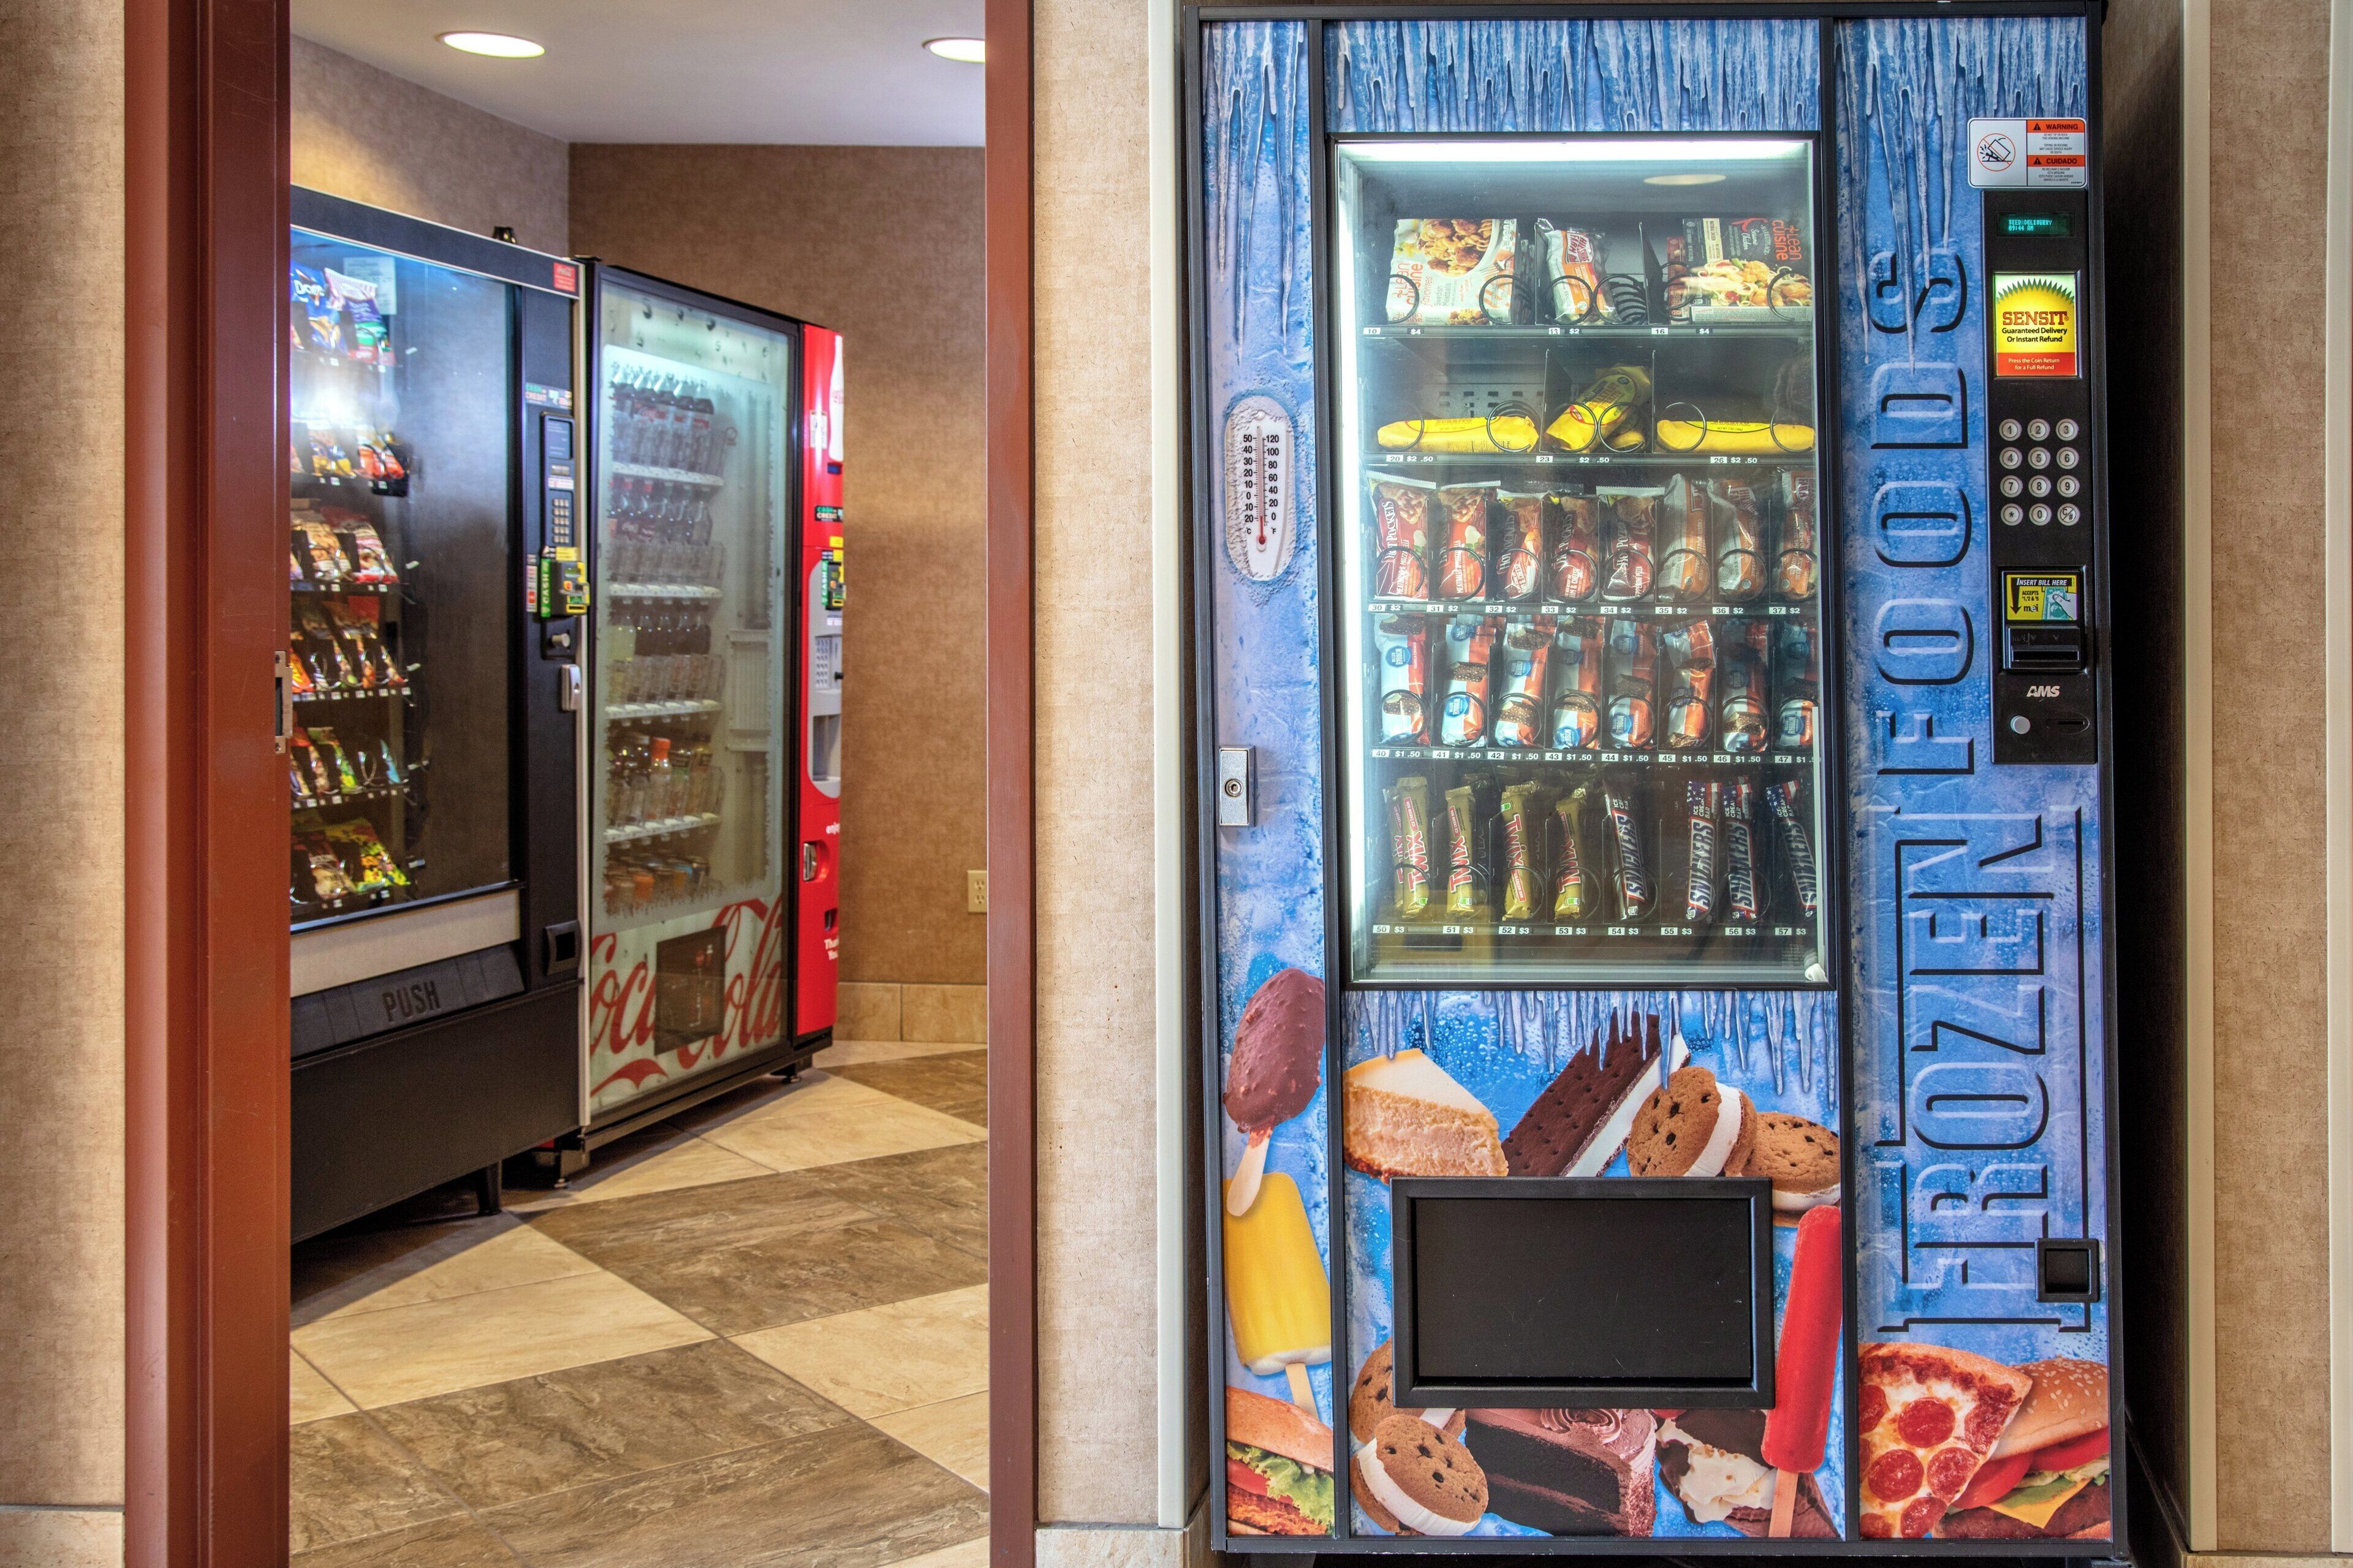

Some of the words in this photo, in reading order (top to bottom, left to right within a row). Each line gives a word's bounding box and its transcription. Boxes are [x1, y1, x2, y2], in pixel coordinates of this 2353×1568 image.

[1569, 235, 1579, 254] FARM
[2041, 327, 2067, 337] Delivery
[2007, 426, 2012, 434] 1
[2036, 426, 2040, 434] 2
[2064, 425, 2069, 434] 3
[2008, 454, 2013, 463] 4
[2036, 454, 2041, 463] 5
[2065, 454, 2070, 463] 6
[1869, 248, 1976, 775] FOODS
[2037, 510, 2042, 519] 0
[1382, 501, 1398, 541] POCKETS
[2026, 686, 2060, 697] AMS
[1616, 716, 1624, 733] RIBBON
[382, 980, 441, 1024] PUSH
[1870, 805, 2091, 1333] FROZEN
